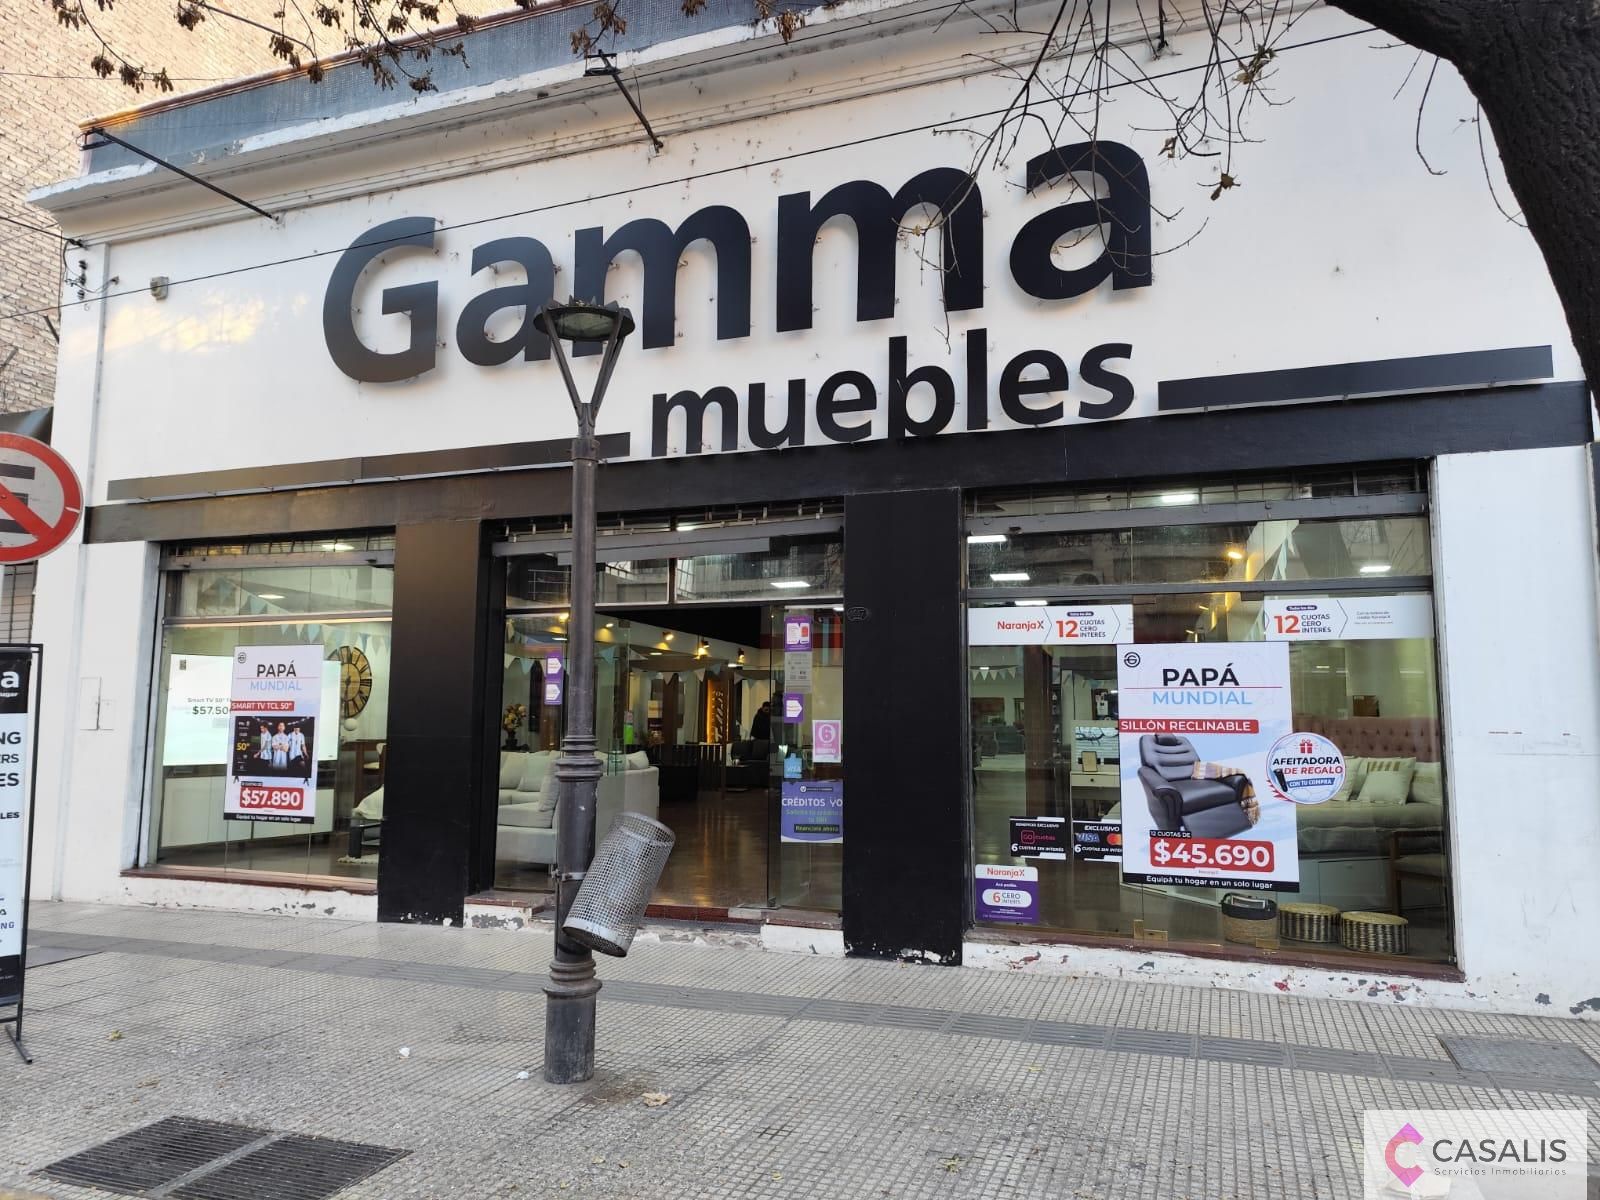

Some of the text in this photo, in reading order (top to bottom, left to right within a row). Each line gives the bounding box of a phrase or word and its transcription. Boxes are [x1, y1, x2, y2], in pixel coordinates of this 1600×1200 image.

[323, 140, 1152, 383] Gamma
[651, 328, 1134, 457] muebles
[1055, 620, 1079, 638] 12
[1274, 614, 1301, 633] 12
[256, 660, 297, 678] PAPÁ
[1162, 662, 1240, 687] PAPÁ
[250, 680, 302, 691] MUNDIAL
[1153, 691, 1253, 705] MUNDIAL
[192, 705, 230, 715] $57.50
[232, 702, 256, 710] SMART
[256, 702, 267, 710] TV
[267, 702, 281, 710] TCL
[1121, 719, 1251, 732] SILLÓN RECLINABLE
[0, 753, 20, 764] RS
[1272, 756, 1341, 765] AFEITADORA
[1284, 766, 1343, 775] DE REGALO
[241, 788, 301, 807] $57.890
[781, 797, 826, 807] CRÉDITOS
[1075, 832, 1100, 843] VISA
[1011, 843, 1018, 852] 6
[1074, 844, 1082, 853] 6
[1154, 838, 1270, 867] $45.690
[1146, 875, 1173, 884] Equipá
[1184, 877, 1207, 886] hogar
[1233, 880, 1250, 888] solo
[1252, 881, 1273, 890] lugar
[993, 892, 1001, 903] 6
[1001, 892, 1021, 900] CERO
